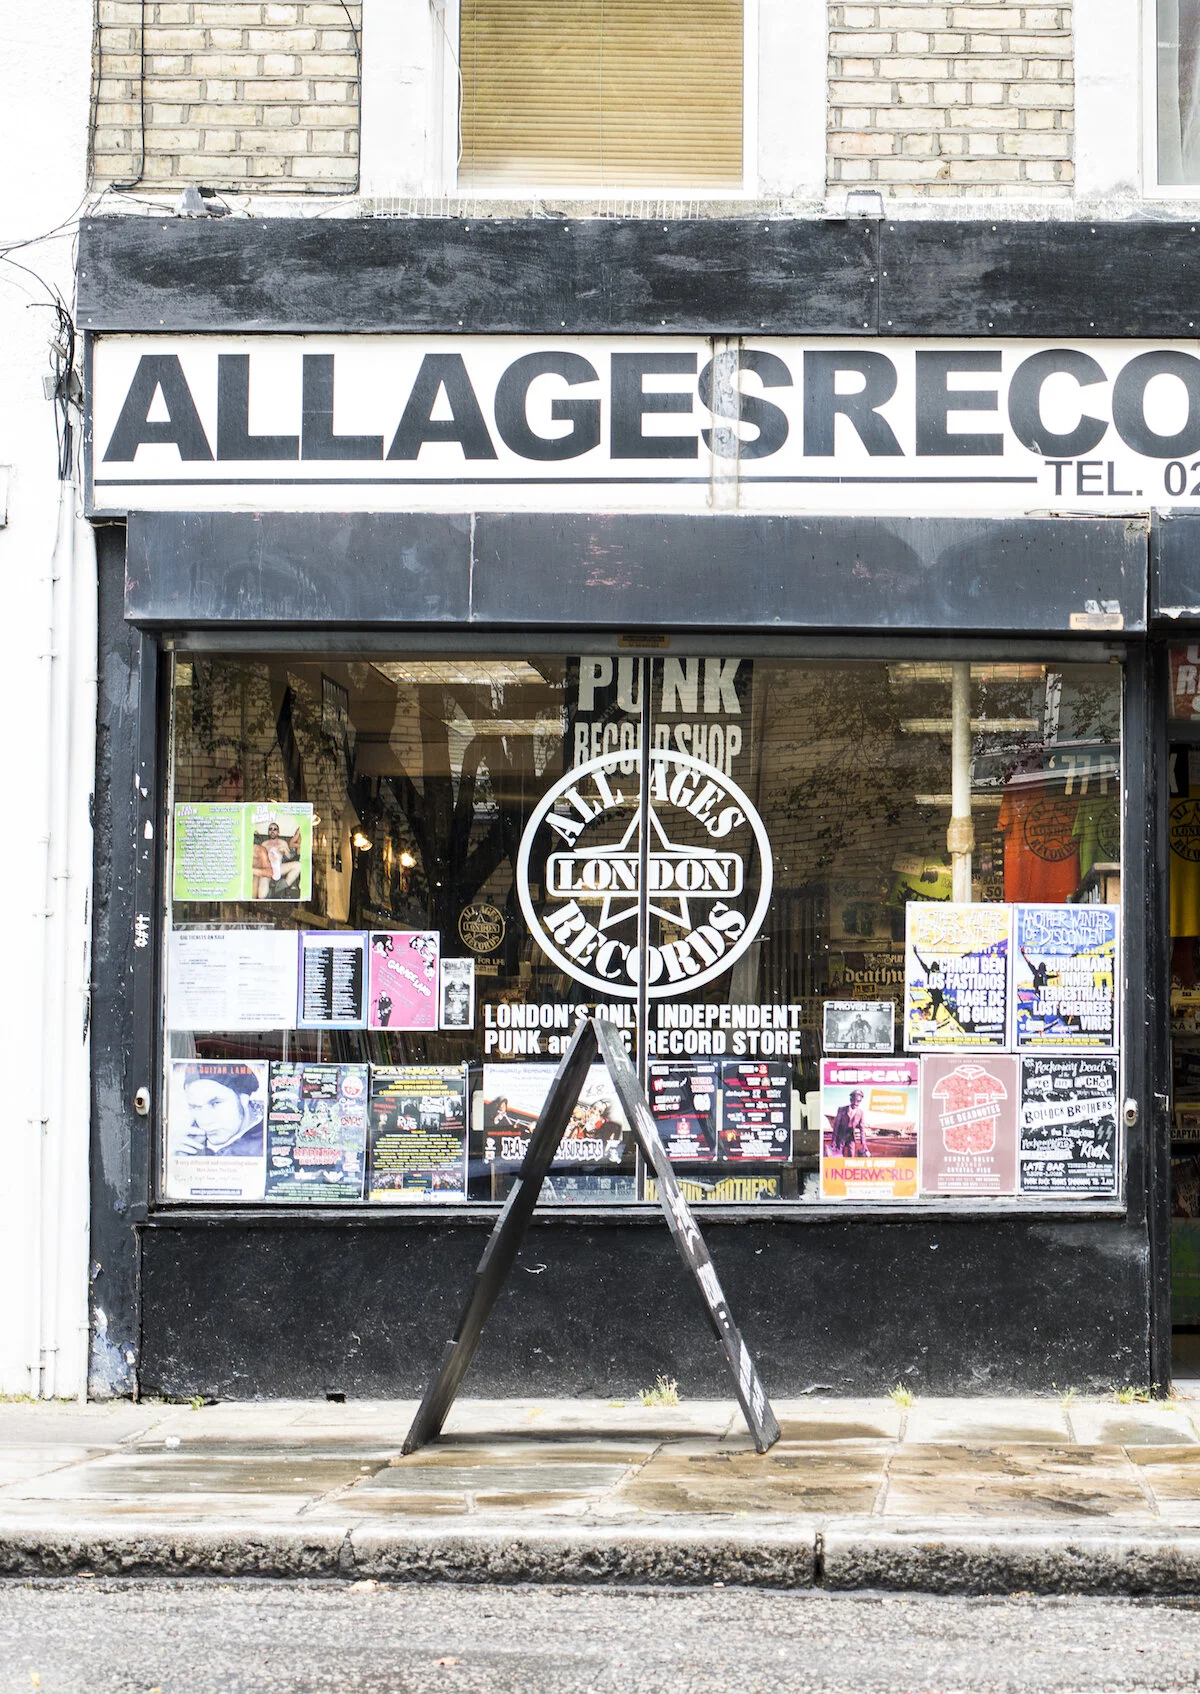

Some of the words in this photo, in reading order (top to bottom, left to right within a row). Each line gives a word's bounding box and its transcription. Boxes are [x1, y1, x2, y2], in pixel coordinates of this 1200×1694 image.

[1045, 460, 1143, 498] TEL.
[578, 657, 742, 714] PUNK
[545, 767, 625, 847] ALL
[635, 763, 747, 838] AGES
[557, 859, 732, 891] LONDON
[543, 899, 748, 985] RECORDS
[946, 973, 1006, 990] FASTIDIOS
[484, 1003, 589, 1029] LONDON'S
[657, 1003, 802, 1030] INDEPENDENT
[1033, 1000, 1058, 1015] LOST
[1080, 1015, 1112, 1030] VIRUS
[484, 1030, 542, 1055] PUNK
[646, 1031, 726, 1056] RECORD
[733, 1031, 802, 1056] STORE
[830, 1070, 910, 1082] HEPCAT
